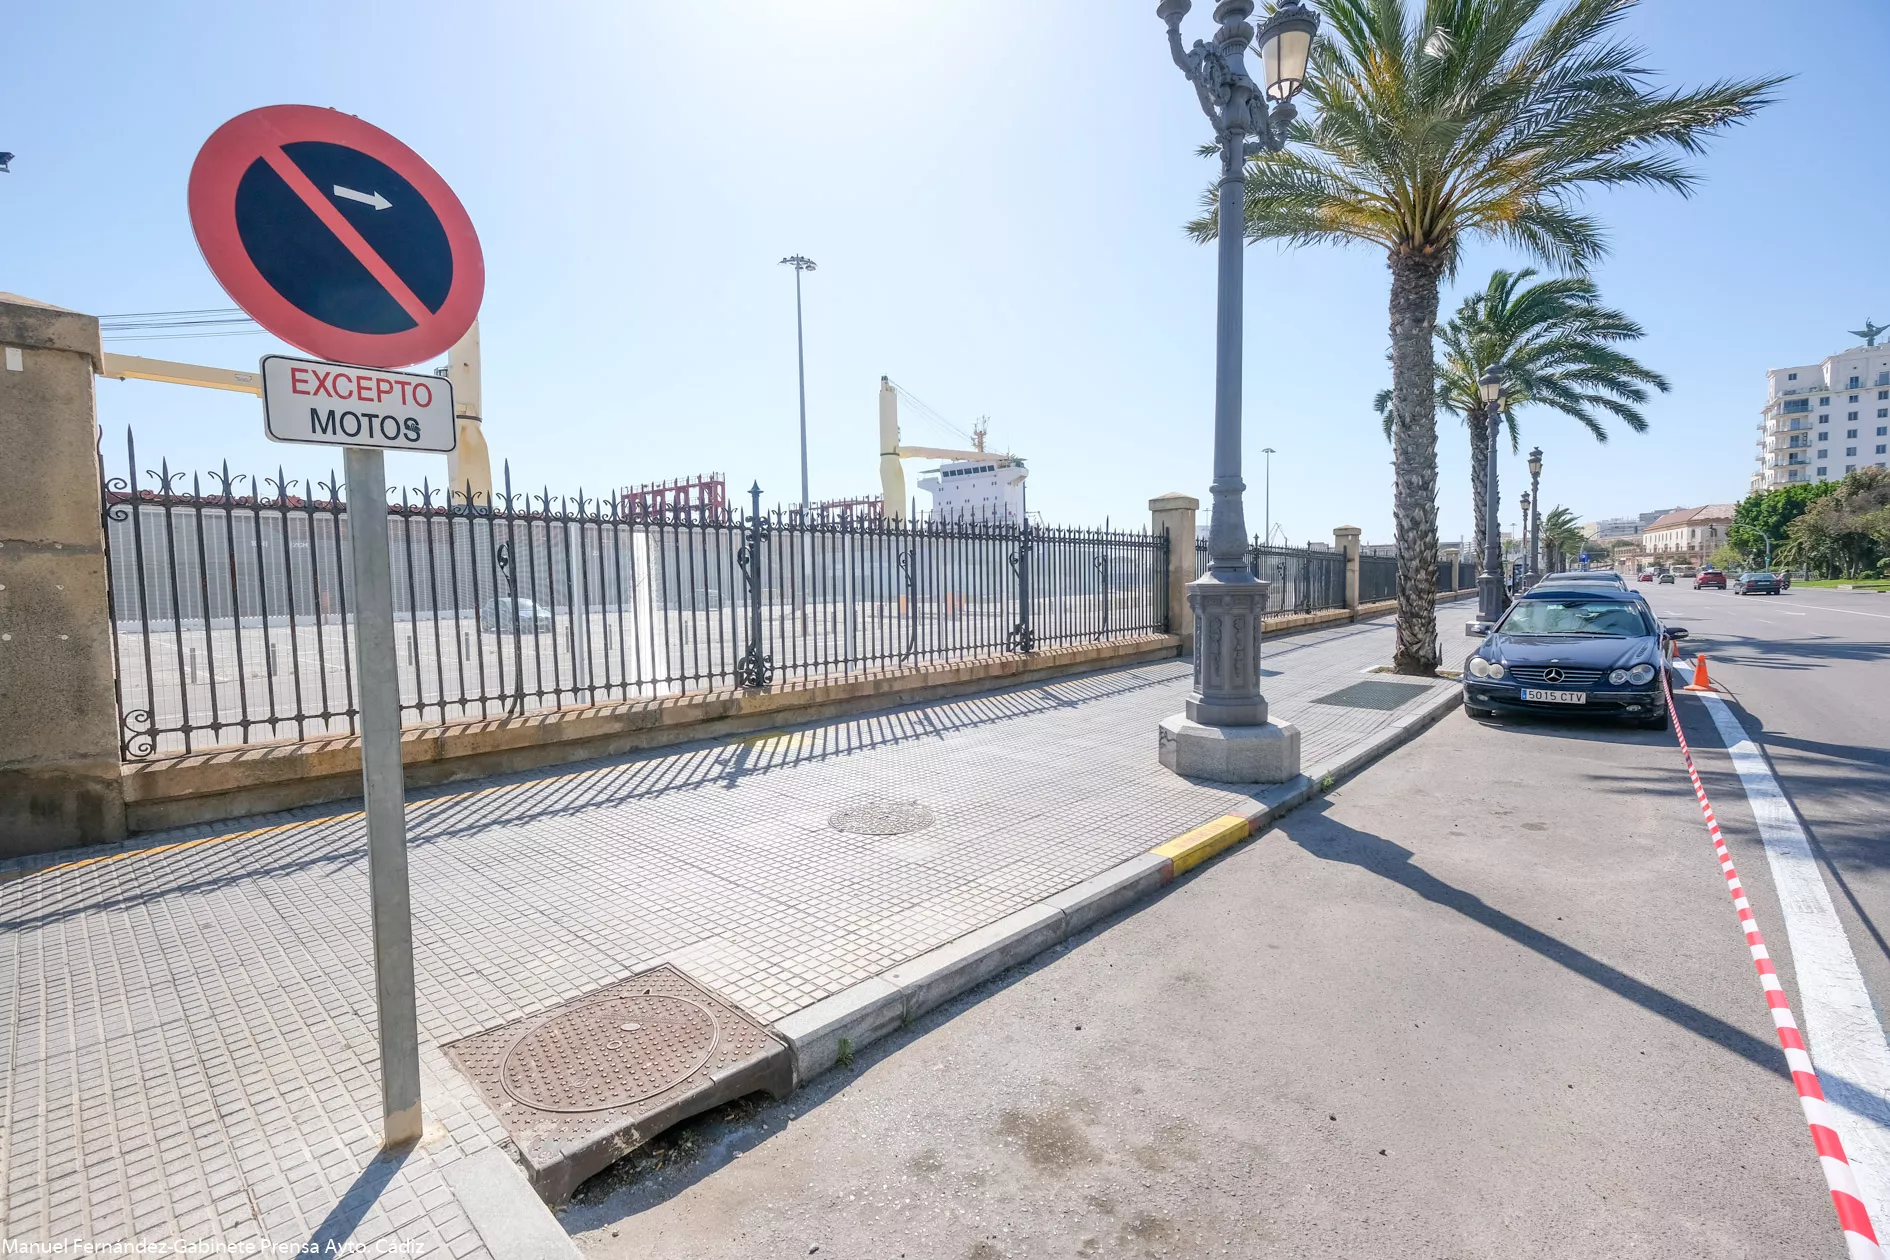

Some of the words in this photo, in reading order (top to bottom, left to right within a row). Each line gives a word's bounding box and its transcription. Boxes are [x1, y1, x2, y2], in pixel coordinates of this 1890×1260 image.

[290, 367, 433, 408] EXCEPTO
[310, 407, 421, 442] MOTOS
[1528, 690, 1557, 701] 5015
[1560, 692, 1583, 702] CTV
